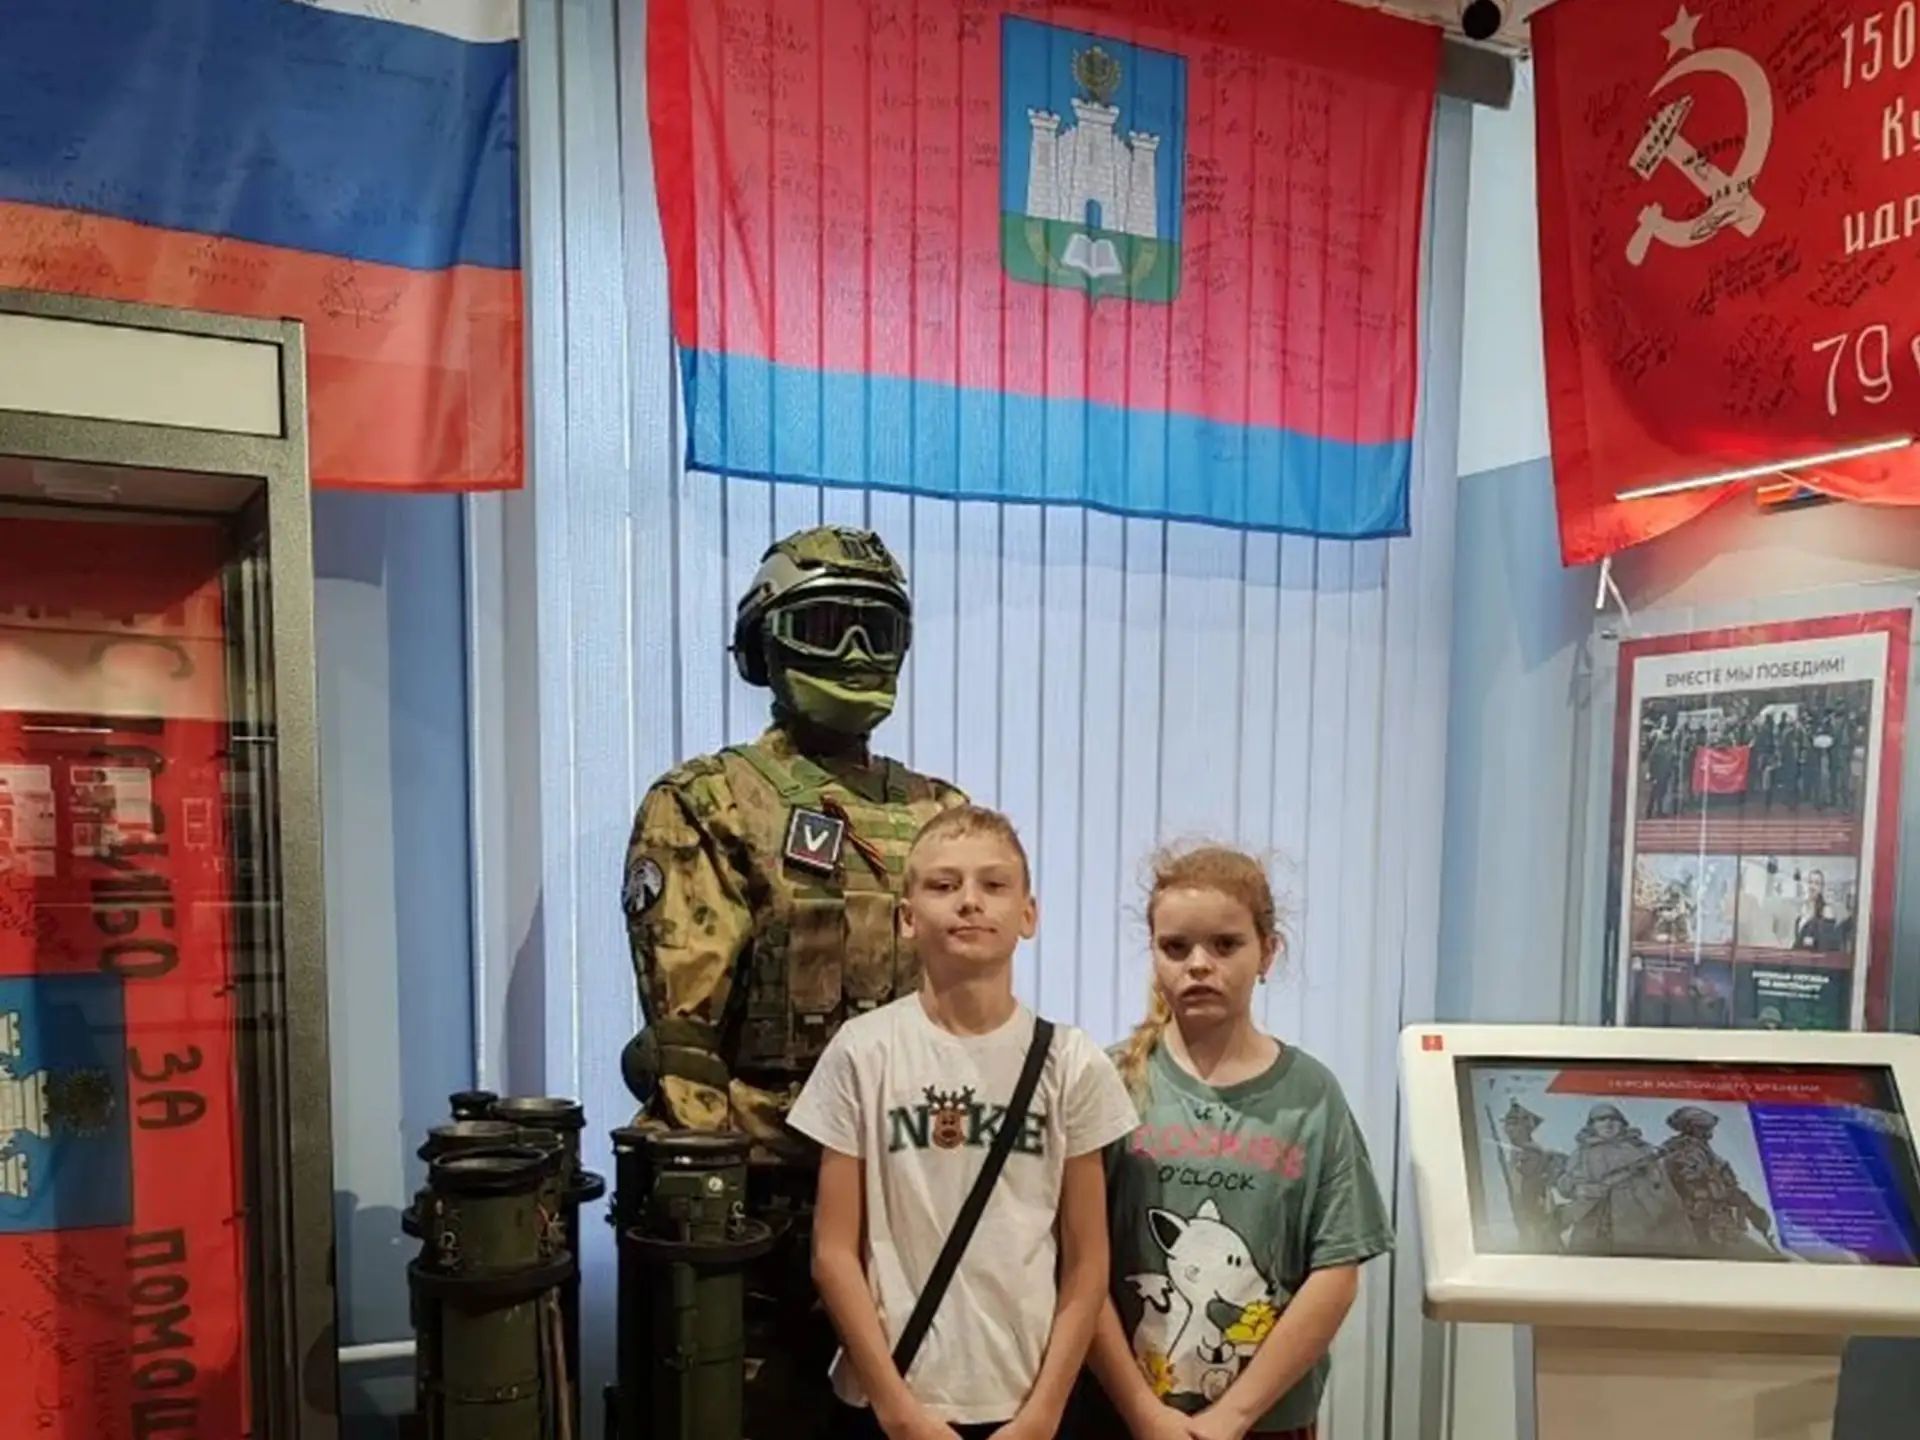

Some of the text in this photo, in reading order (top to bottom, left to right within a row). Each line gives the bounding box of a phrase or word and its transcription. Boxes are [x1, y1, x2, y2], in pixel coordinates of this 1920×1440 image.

[1841, 1, 1917, 90] 150
[1812, 324, 1892, 416] 79
[1665, 656, 1845, 688] ВМЕСТЕ МЫ ПОБЕДИМ!
[804, 824, 829, 852] V
[130, 1045, 207, 1131] ЗА
[888, 1103, 1048, 1156] NKE
[1158, 1164, 1257, 1191] O'CLOCK
